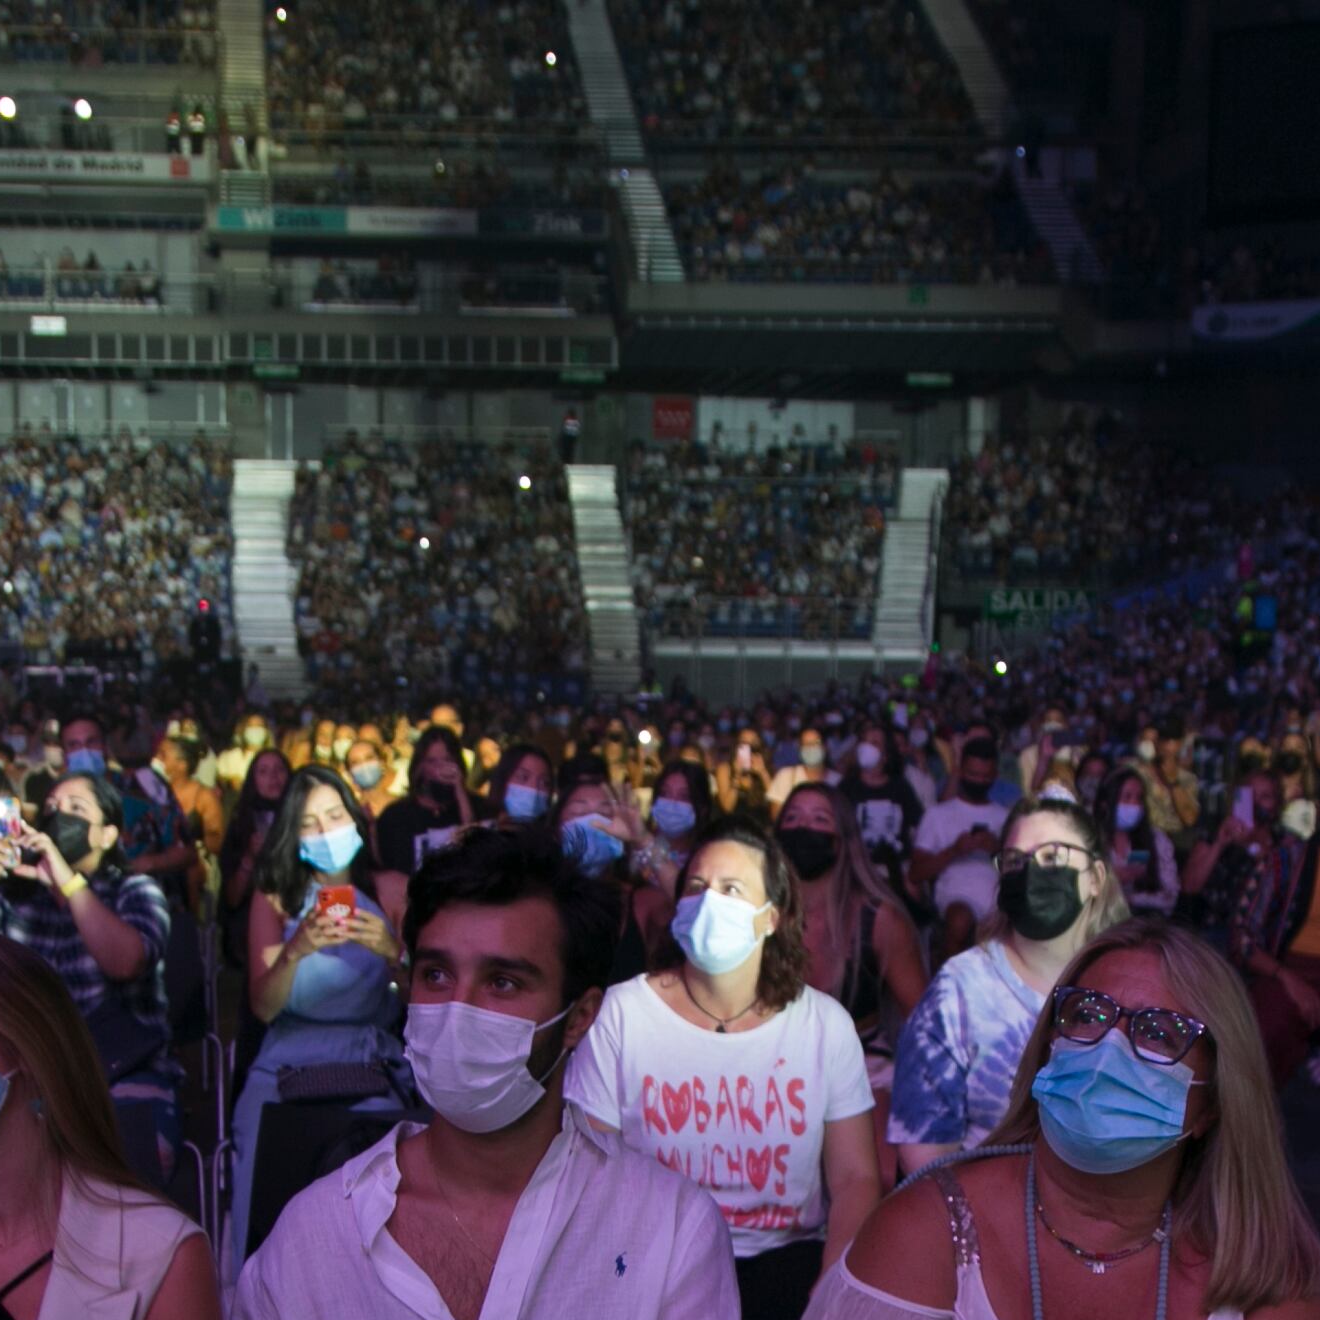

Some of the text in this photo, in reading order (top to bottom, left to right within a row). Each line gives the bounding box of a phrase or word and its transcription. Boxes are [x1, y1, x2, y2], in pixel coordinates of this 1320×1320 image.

[52, 156, 75, 170] de
[82, 155, 144, 172] Madrid
[989, 589, 1091, 613] SALIDA
